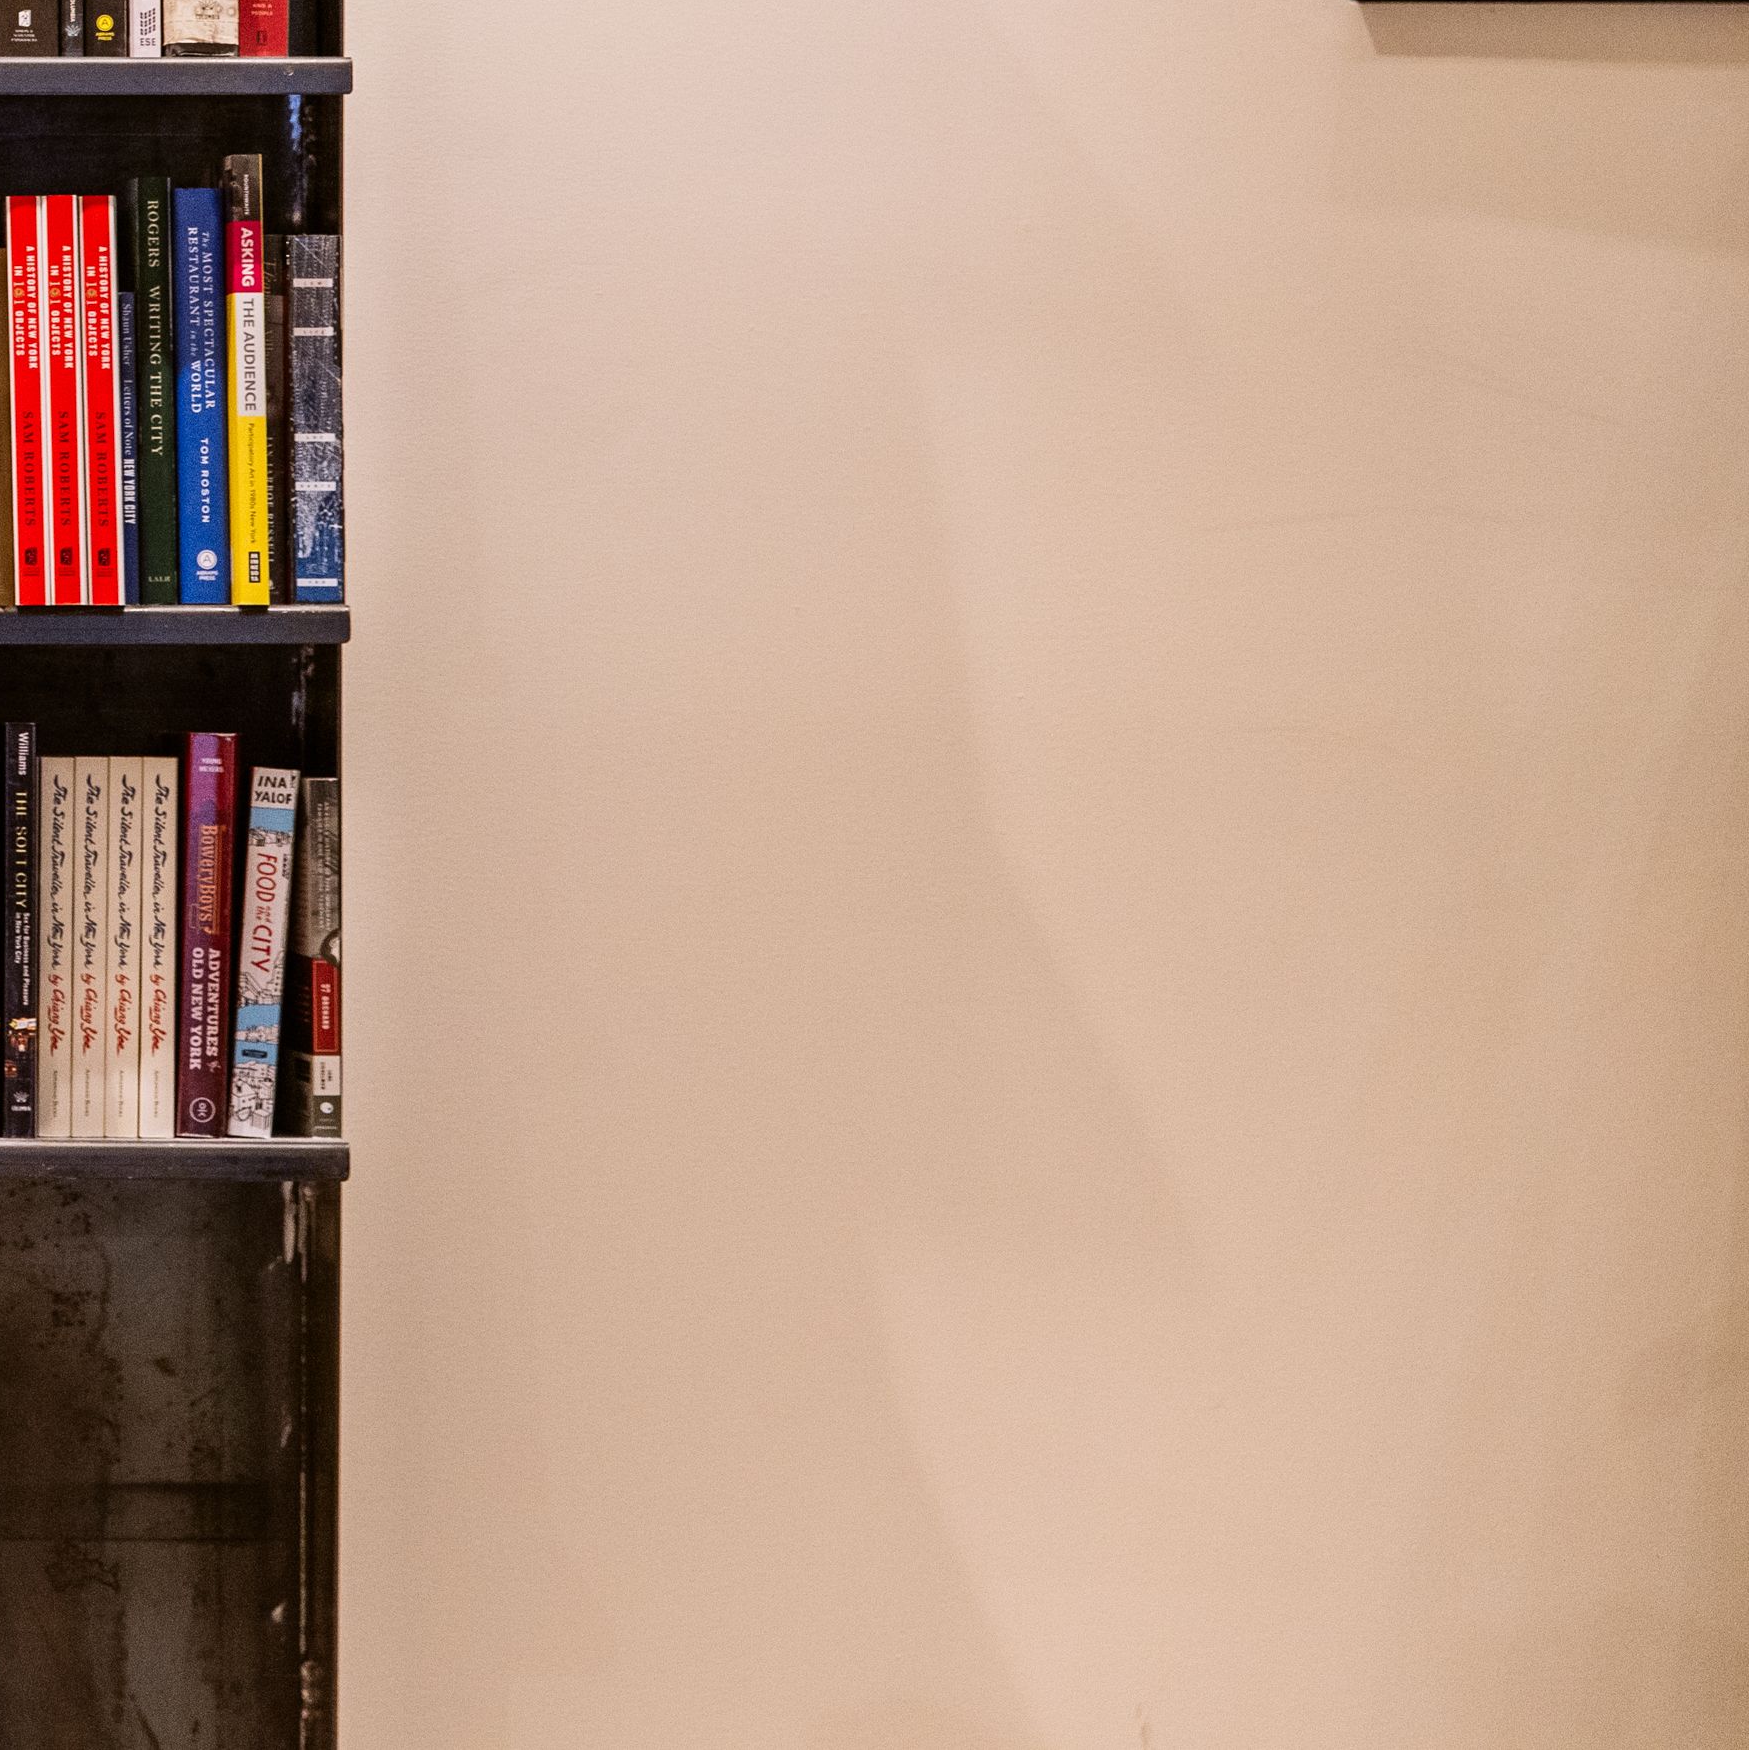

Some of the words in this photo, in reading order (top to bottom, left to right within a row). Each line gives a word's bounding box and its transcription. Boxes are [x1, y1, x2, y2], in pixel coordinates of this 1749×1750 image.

[240, 227, 254, 287] ASKING
[242, 298, 255, 327] THE
[243, 332, 257, 412] AUDIENCE
[258, 775, 287, 788] INA
[255, 790, 292, 805] YALOF
